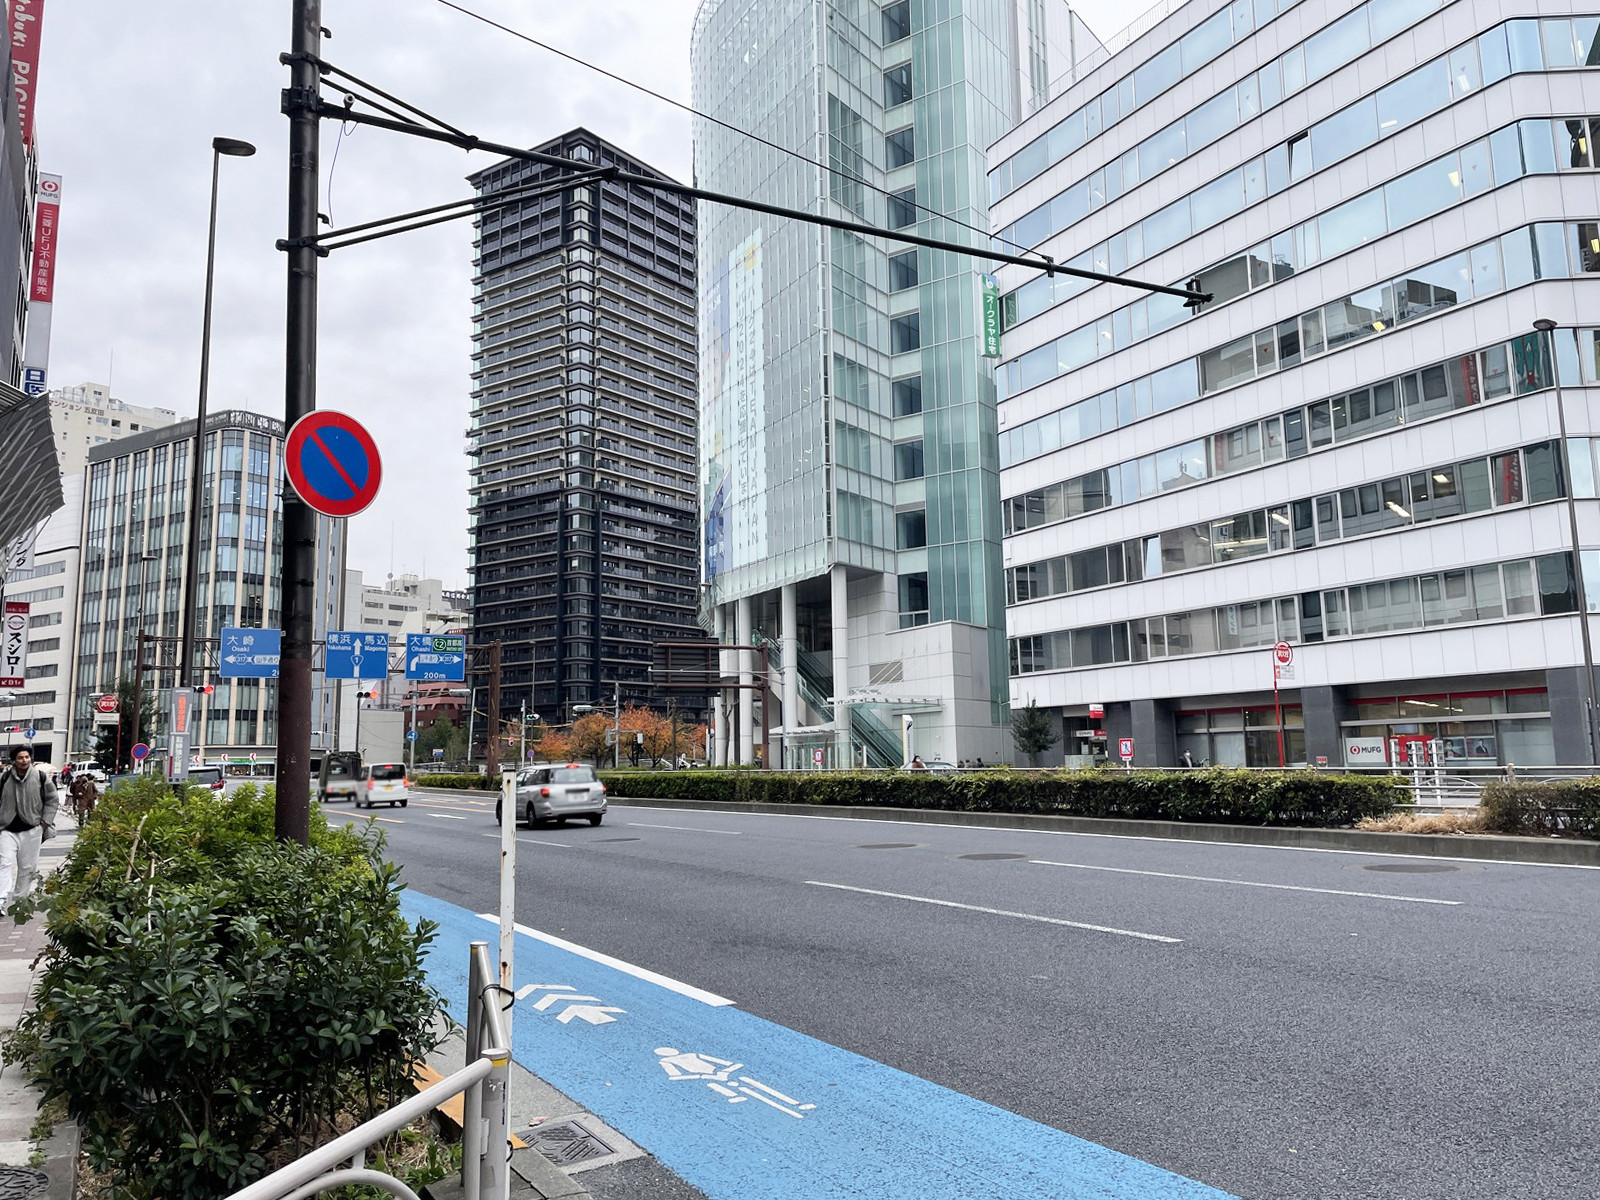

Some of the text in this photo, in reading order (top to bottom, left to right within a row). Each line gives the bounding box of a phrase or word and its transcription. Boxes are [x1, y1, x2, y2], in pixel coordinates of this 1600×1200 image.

[986, 295, 997, 355] オークラヤ住宅
[227, 635, 254, 645] 大崎
[328, 634, 351, 644] 横浜
[364, 635, 387, 645] 馬込
[7, 632, 22, 676] スシロー
[1361, 746, 1382, 754] MUFG
